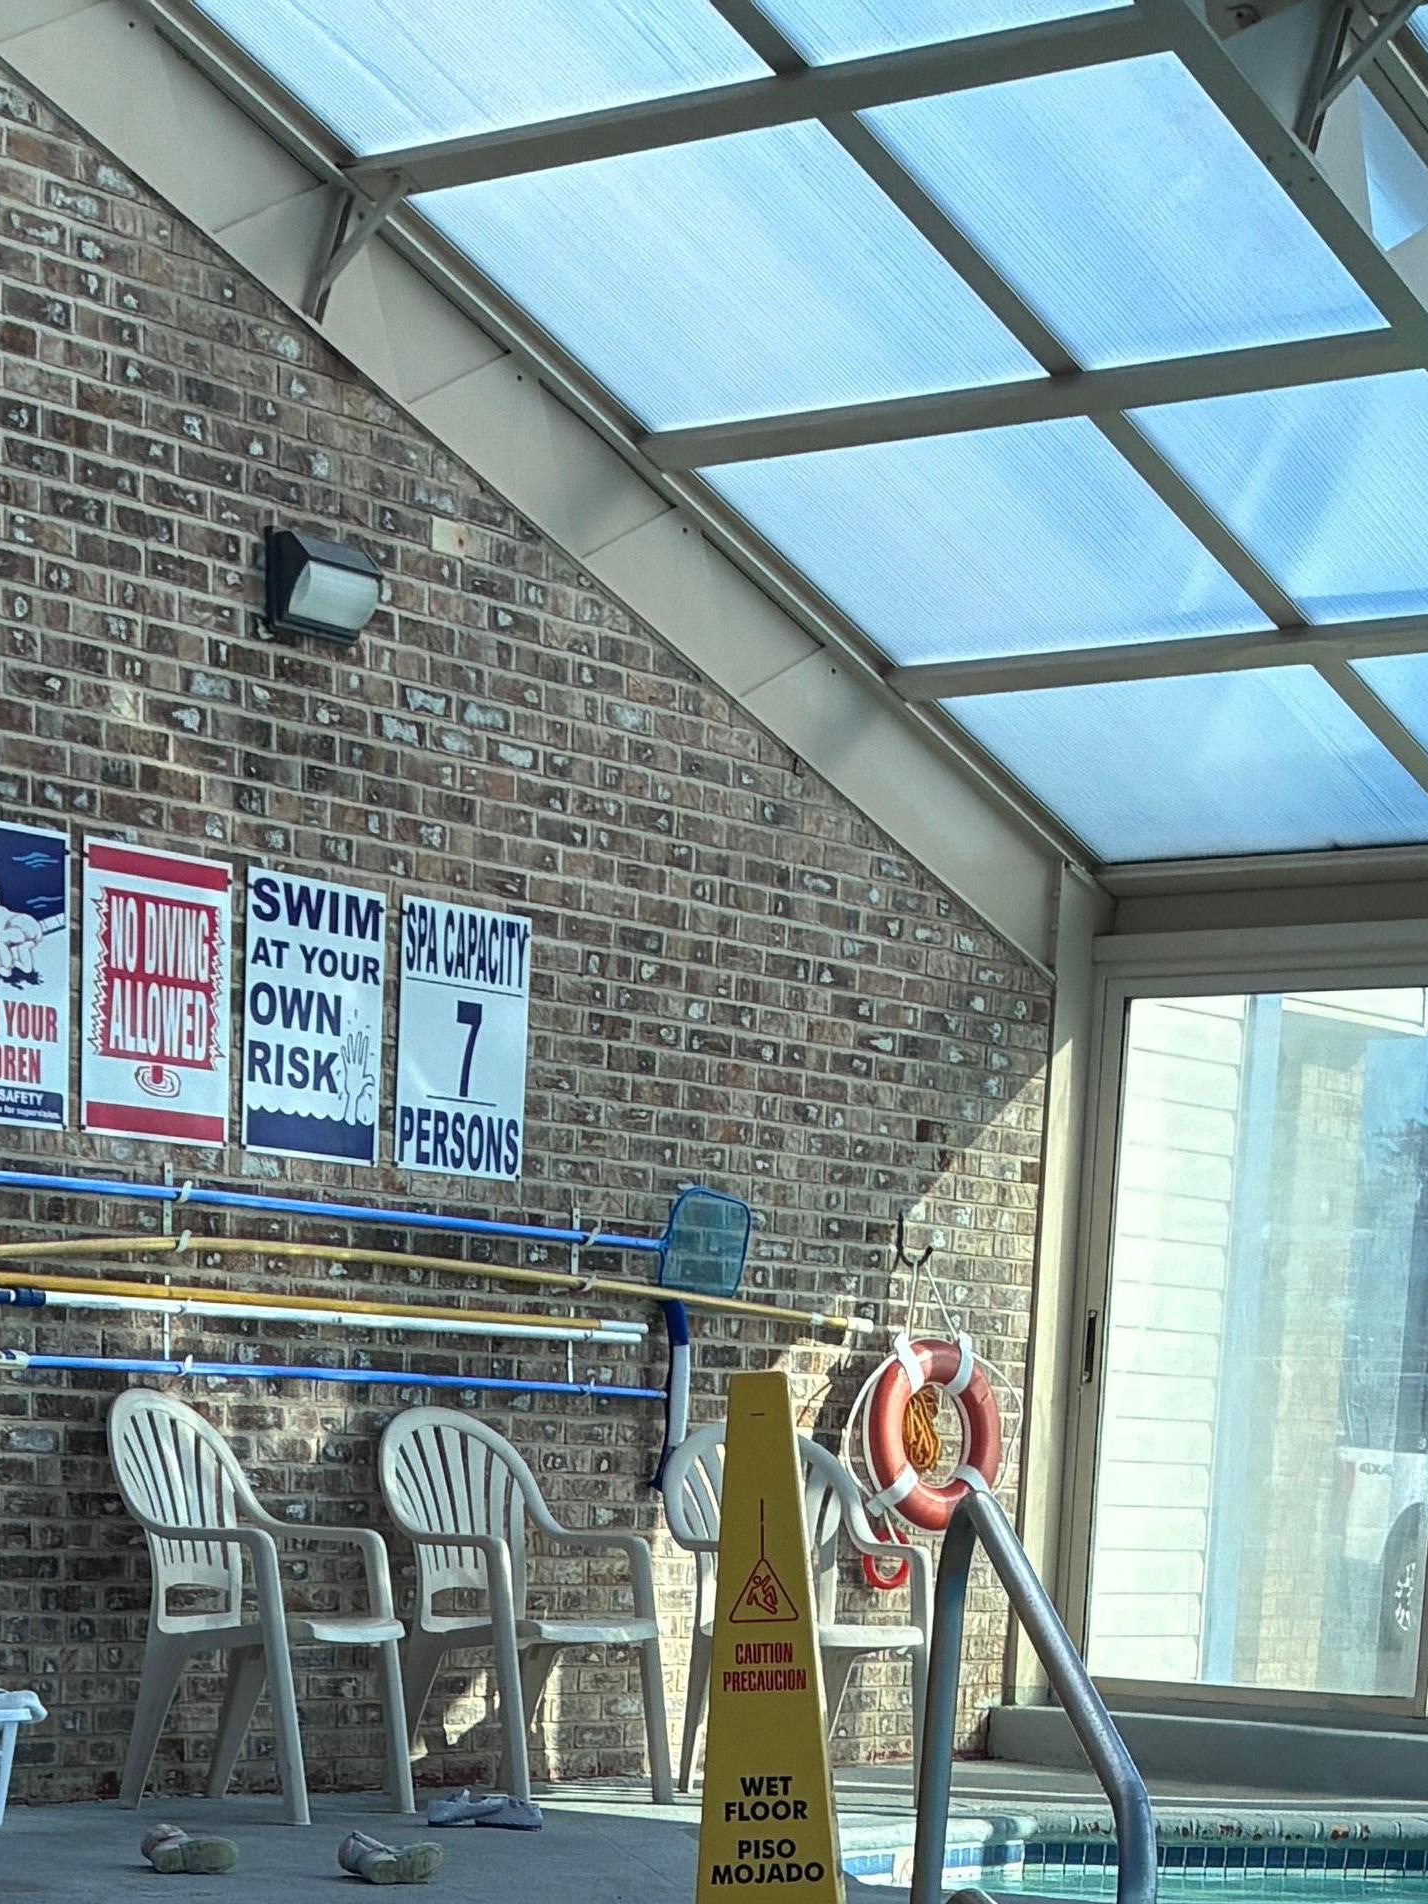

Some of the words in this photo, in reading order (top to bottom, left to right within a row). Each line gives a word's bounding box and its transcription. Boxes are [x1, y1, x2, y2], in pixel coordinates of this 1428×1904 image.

[252, 878, 380, 942] SWIM
[111, 895, 137, 972] NO
[145, 901, 210, 983] DIVING
[251, 937, 289, 969] AT
[299, 944, 380, 985] YOUR
[406, 902, 438, 974] SPA
[444, 909, 528, 988] CAPACITY
[4, 1000, 57, 1042] YOUR
[110, 978, 207, 1061] ALLOWED
[250, 982, 342, 1037] OWN
[248, 1040, 339, 1094] RISK
[457, 1000, 482, 1097] 7
[0, 1089, 44, 1105] SAFETY
[5, 1105, 14, 1113] for
[398, 1105, 519, 1175] PERSONS
[735, 1642, 793, 1664] CAUTION
[723, 1669, 806, 1692] PRECAUCION
[740, 1776, 792, 1796] WET
[725, 1800, 808, 1822] FLOOR
[738, 1839, 796, 1859] PISO
[711, 1862, 825, 1885] MOJADO
